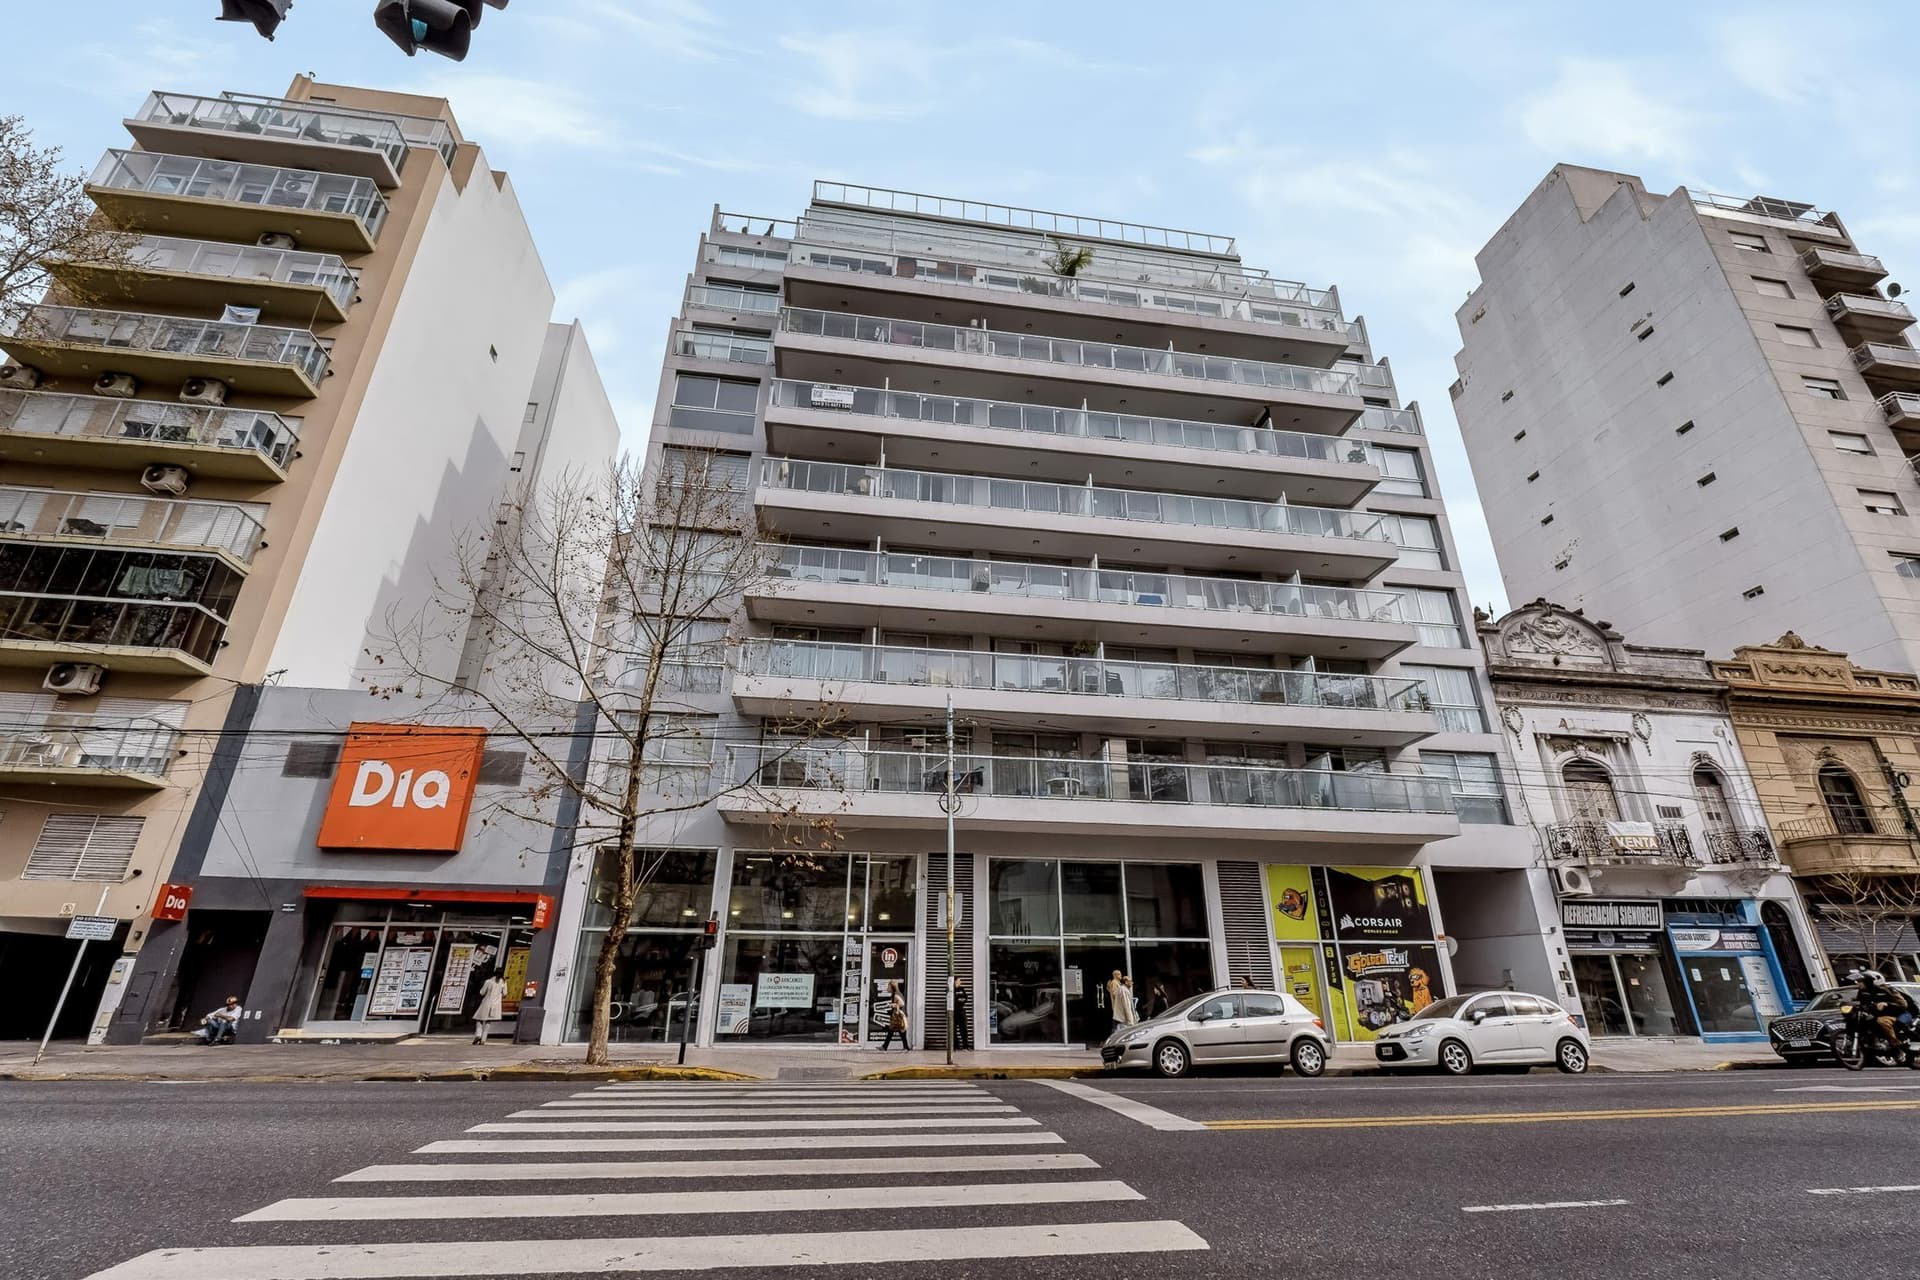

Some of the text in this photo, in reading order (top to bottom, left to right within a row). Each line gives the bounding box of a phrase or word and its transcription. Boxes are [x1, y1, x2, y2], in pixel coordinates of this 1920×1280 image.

[349, 760, 450, 809] Dia
[1615, 836, 1658, 848] VENTA
[165, 895, 186, 909] Dia
[1563, 902, 1659, 926] REFRIGERACIÓN SIGNORELLI
[1355, 917, 1402, 927] CORSAIR
